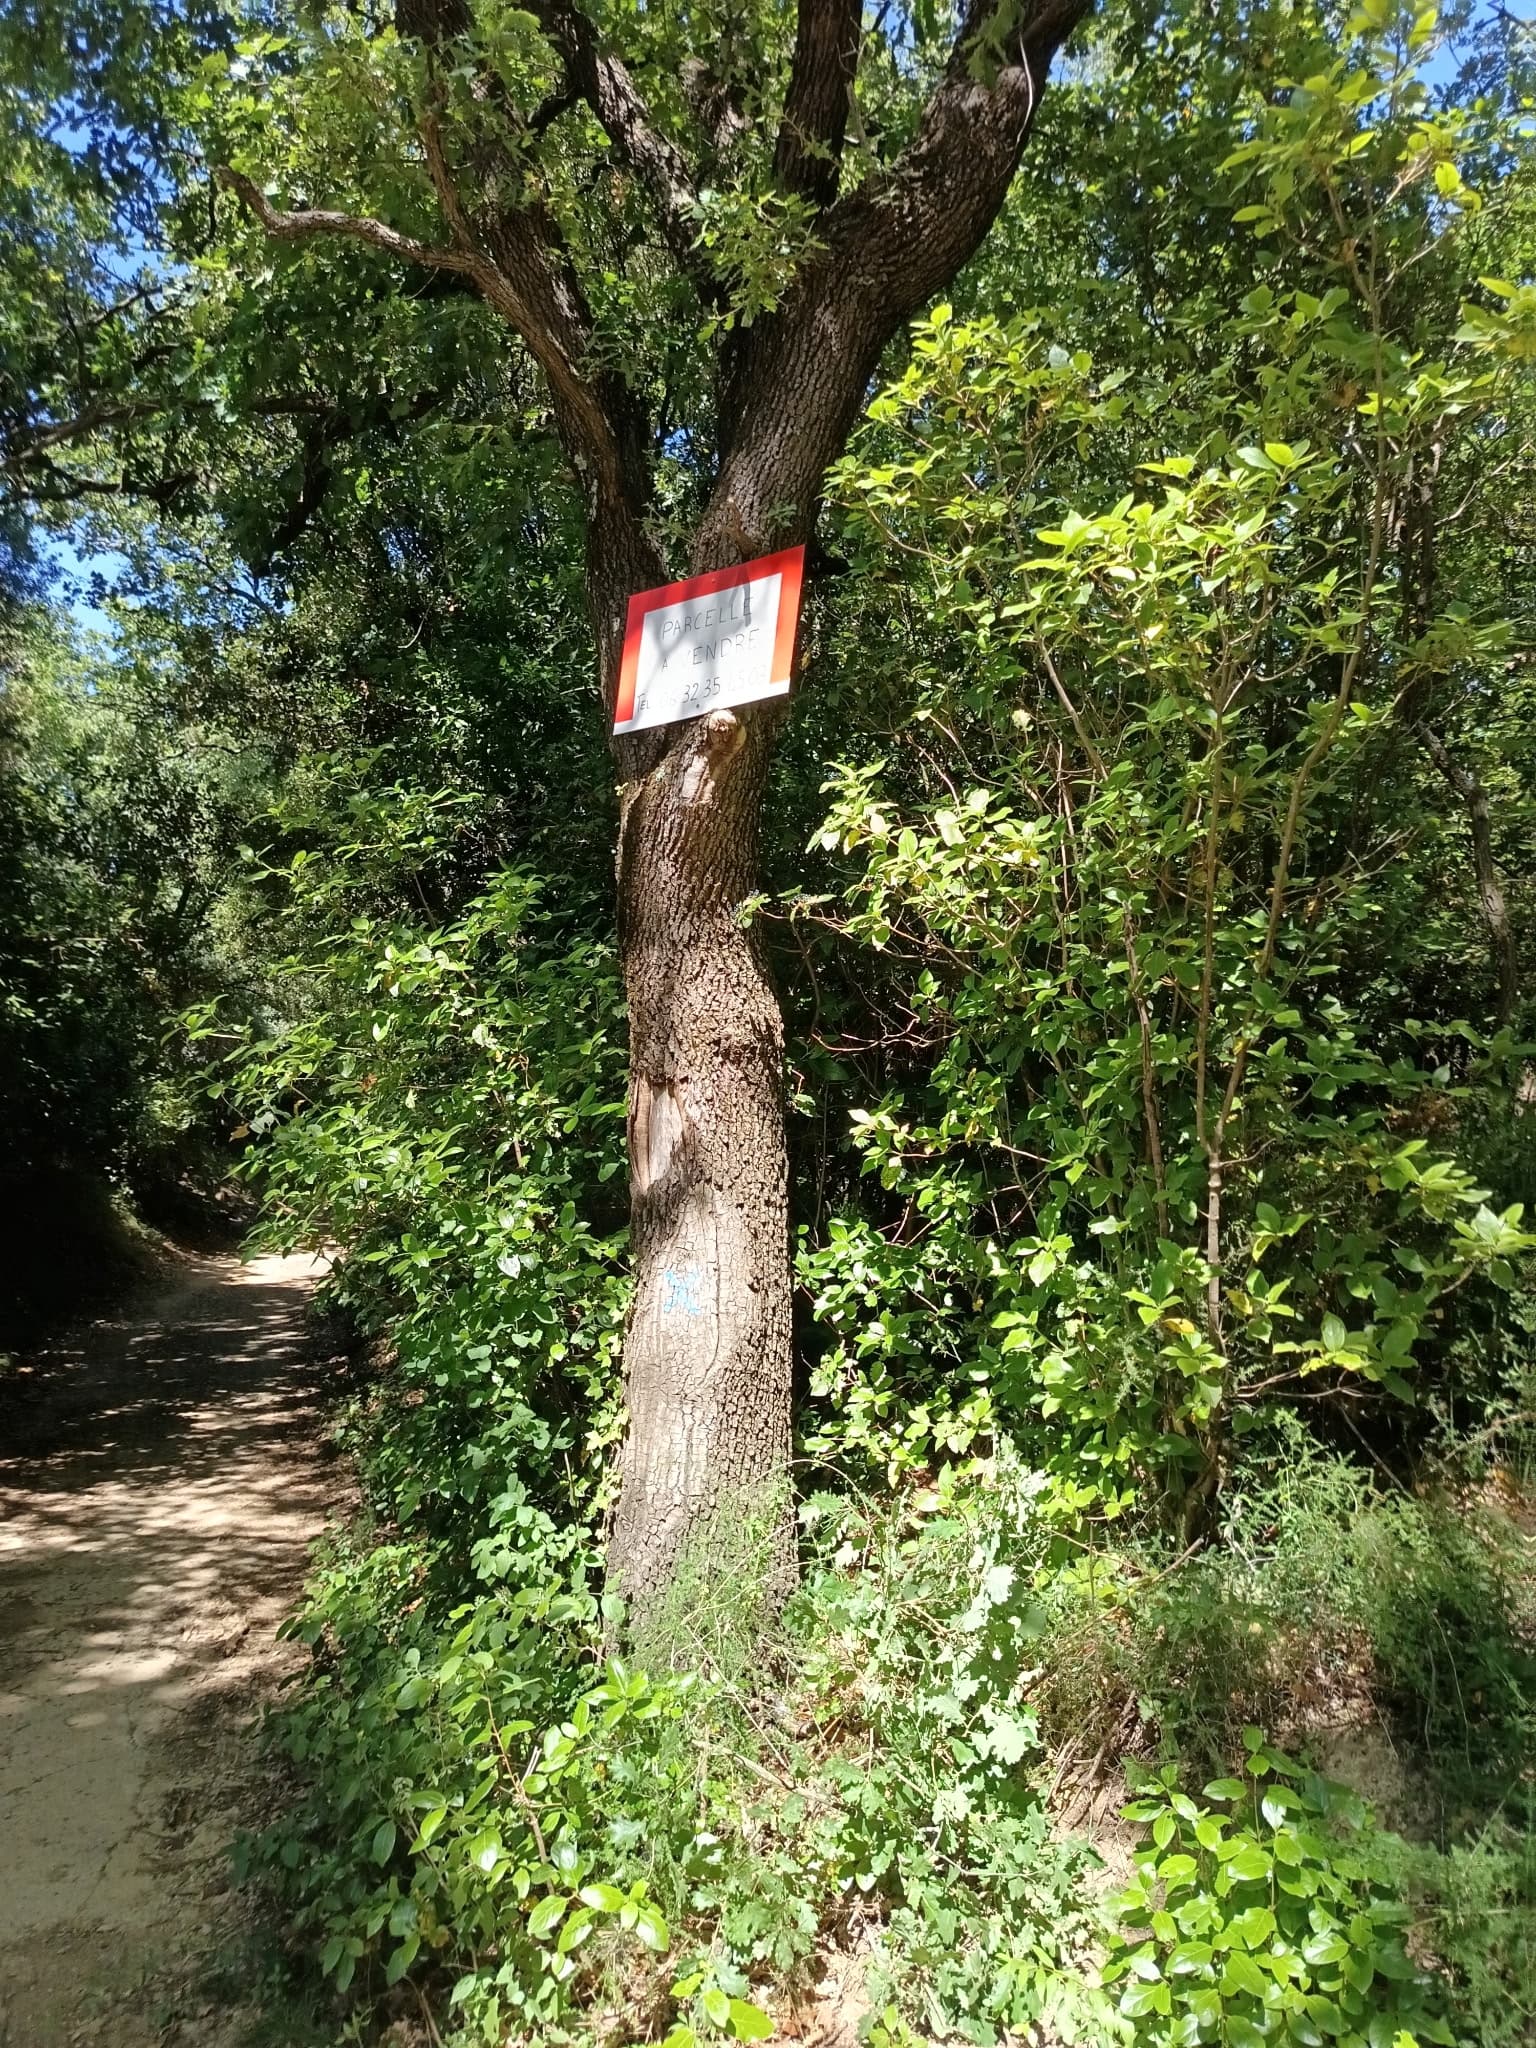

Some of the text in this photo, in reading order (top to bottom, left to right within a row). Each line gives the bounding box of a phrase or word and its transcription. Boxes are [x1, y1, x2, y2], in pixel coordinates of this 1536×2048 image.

[662, 597, 754, 640] PARCELLE
[681, 628, 760, 665] ENDRE
[682, 682, 700, 703] 32
[703, 676, 721, 698] 35
